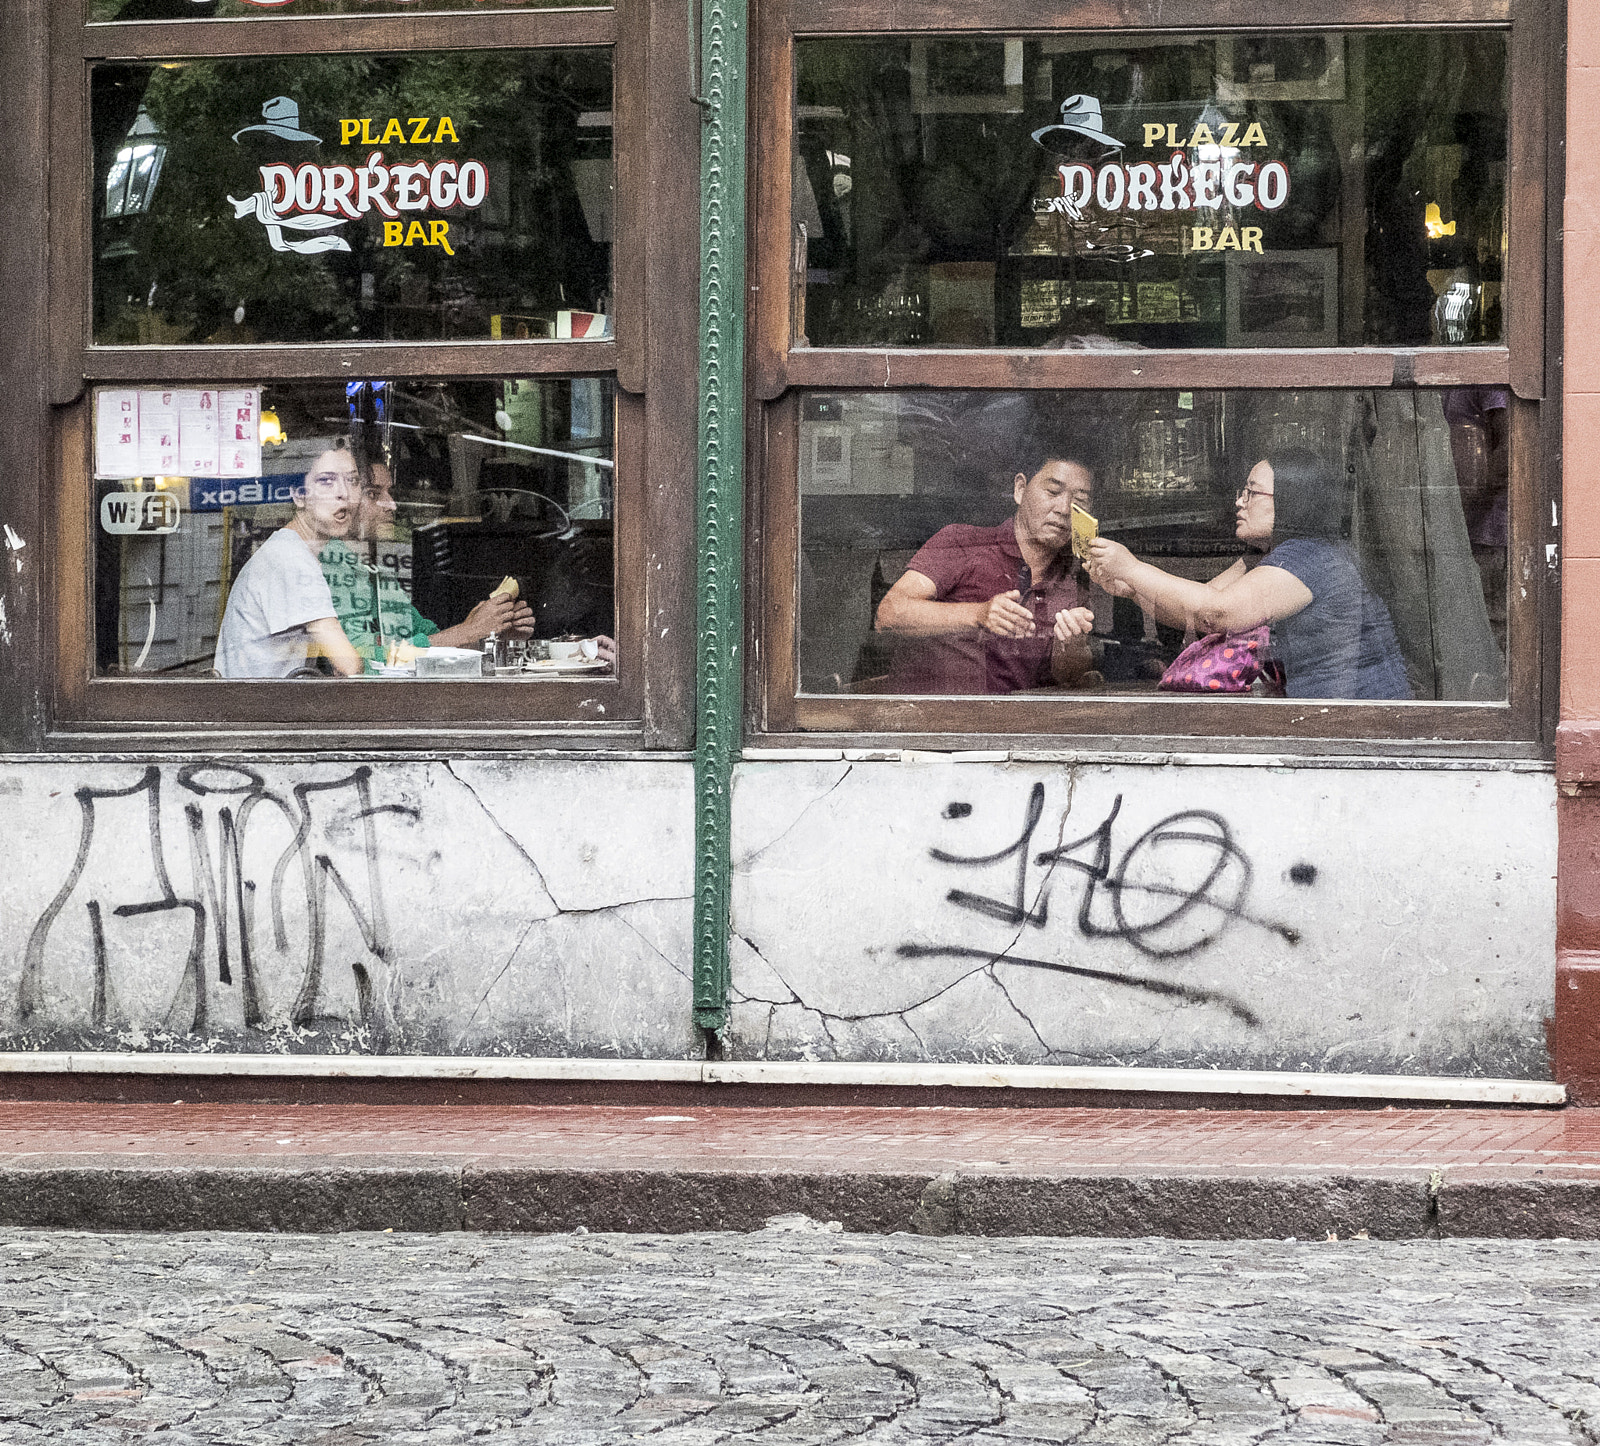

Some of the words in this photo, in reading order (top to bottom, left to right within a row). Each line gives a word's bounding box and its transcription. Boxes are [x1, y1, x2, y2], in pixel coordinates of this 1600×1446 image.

[338, 116, 460, 146] PLAZA
[1142, 122, 1268, 148] PLAZA
[259, 151, 489, 219] DORREGO
[1058, 151, 1291, 211] DORREGO
[382, 219, 455, 256] BAR
[1190, 226, 1265, 255] BAR
